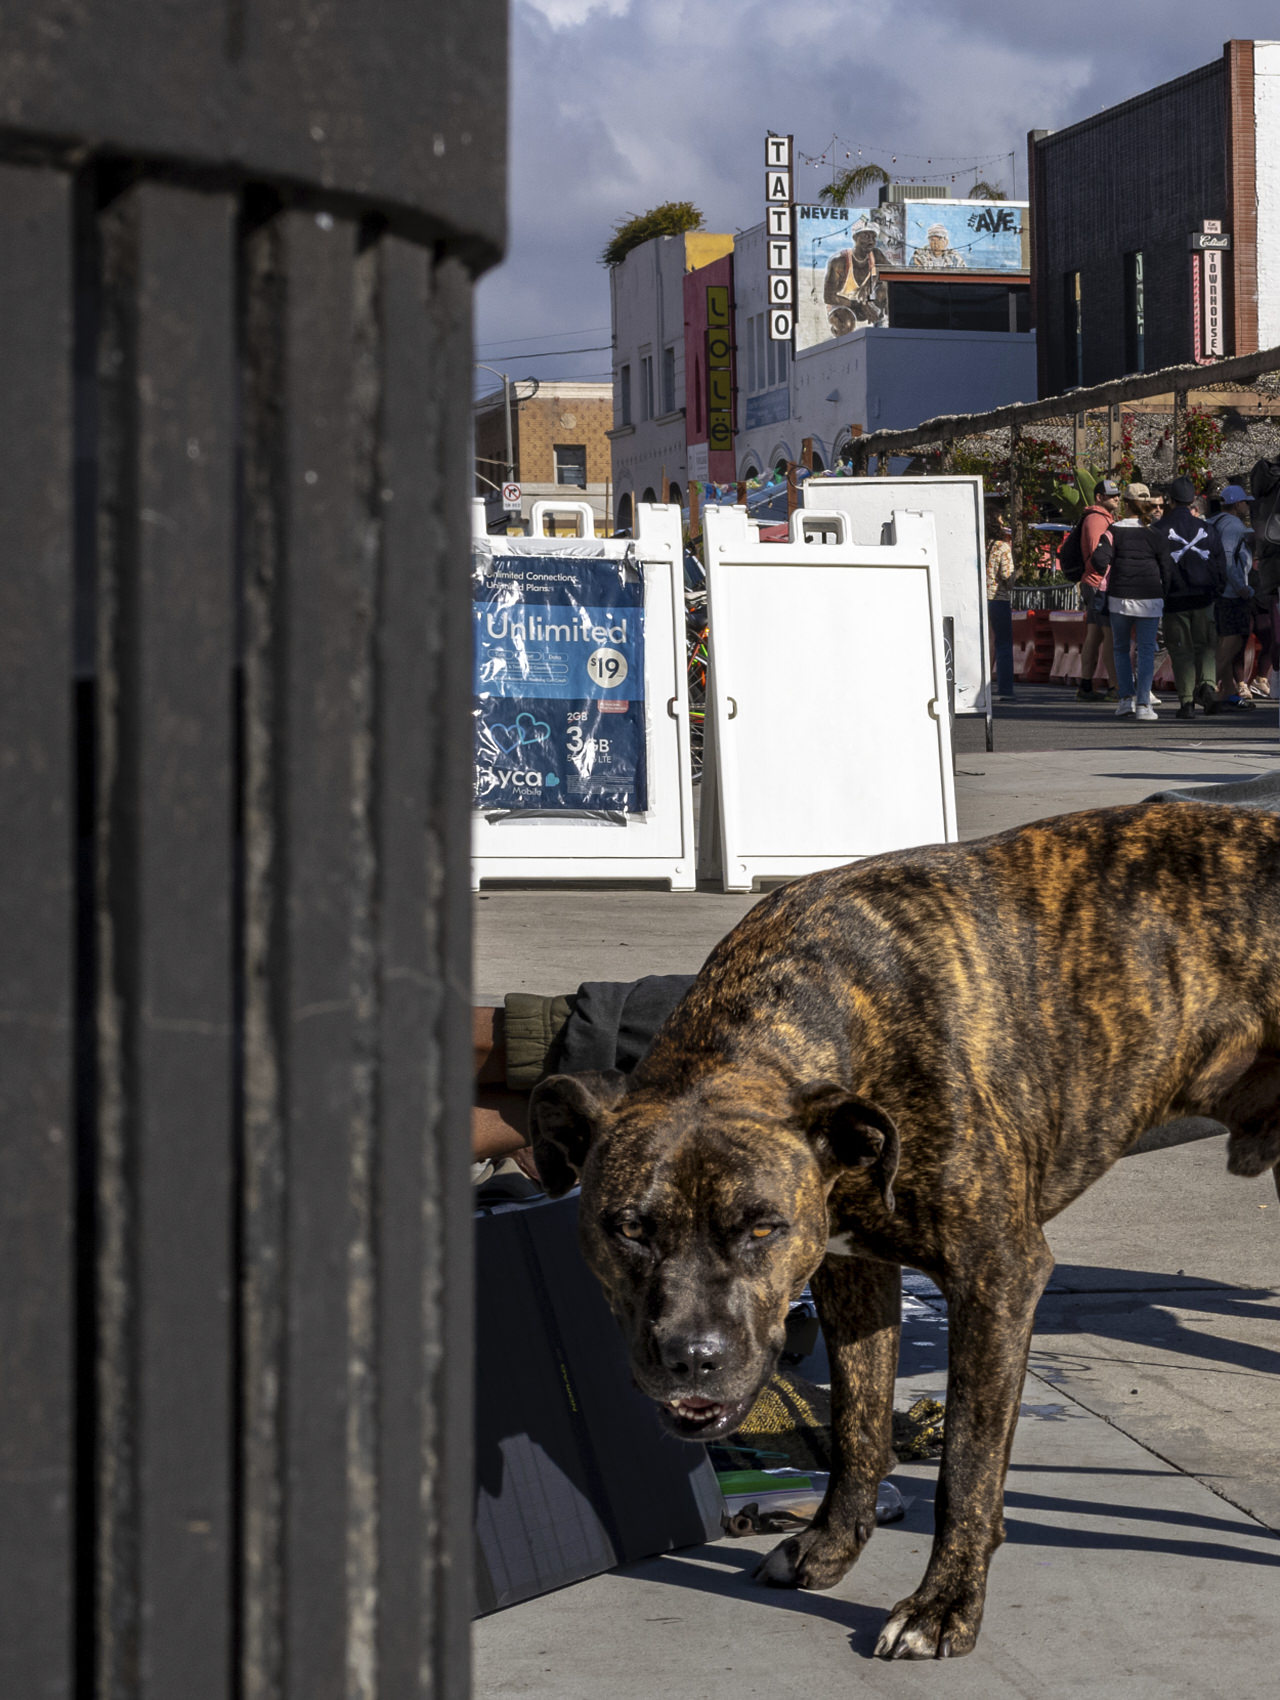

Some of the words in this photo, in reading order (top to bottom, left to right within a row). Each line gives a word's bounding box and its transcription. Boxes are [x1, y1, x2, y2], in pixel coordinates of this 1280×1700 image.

[800, 206, 849, 221] NEVER
[975, 207, 1014, 233] AVE
[770, 140, 789, 336] TATTOO
[1208, 252, 1218, 349] TOWNHOUSE
[486, 581, 524, 591] Unlimid
[486, 613, 627, 644] Unlimited
[590, 657, 620, 679] $19
[567, 712, 588, 722] 2GB
[512, 786, 542, 796] Mobile
